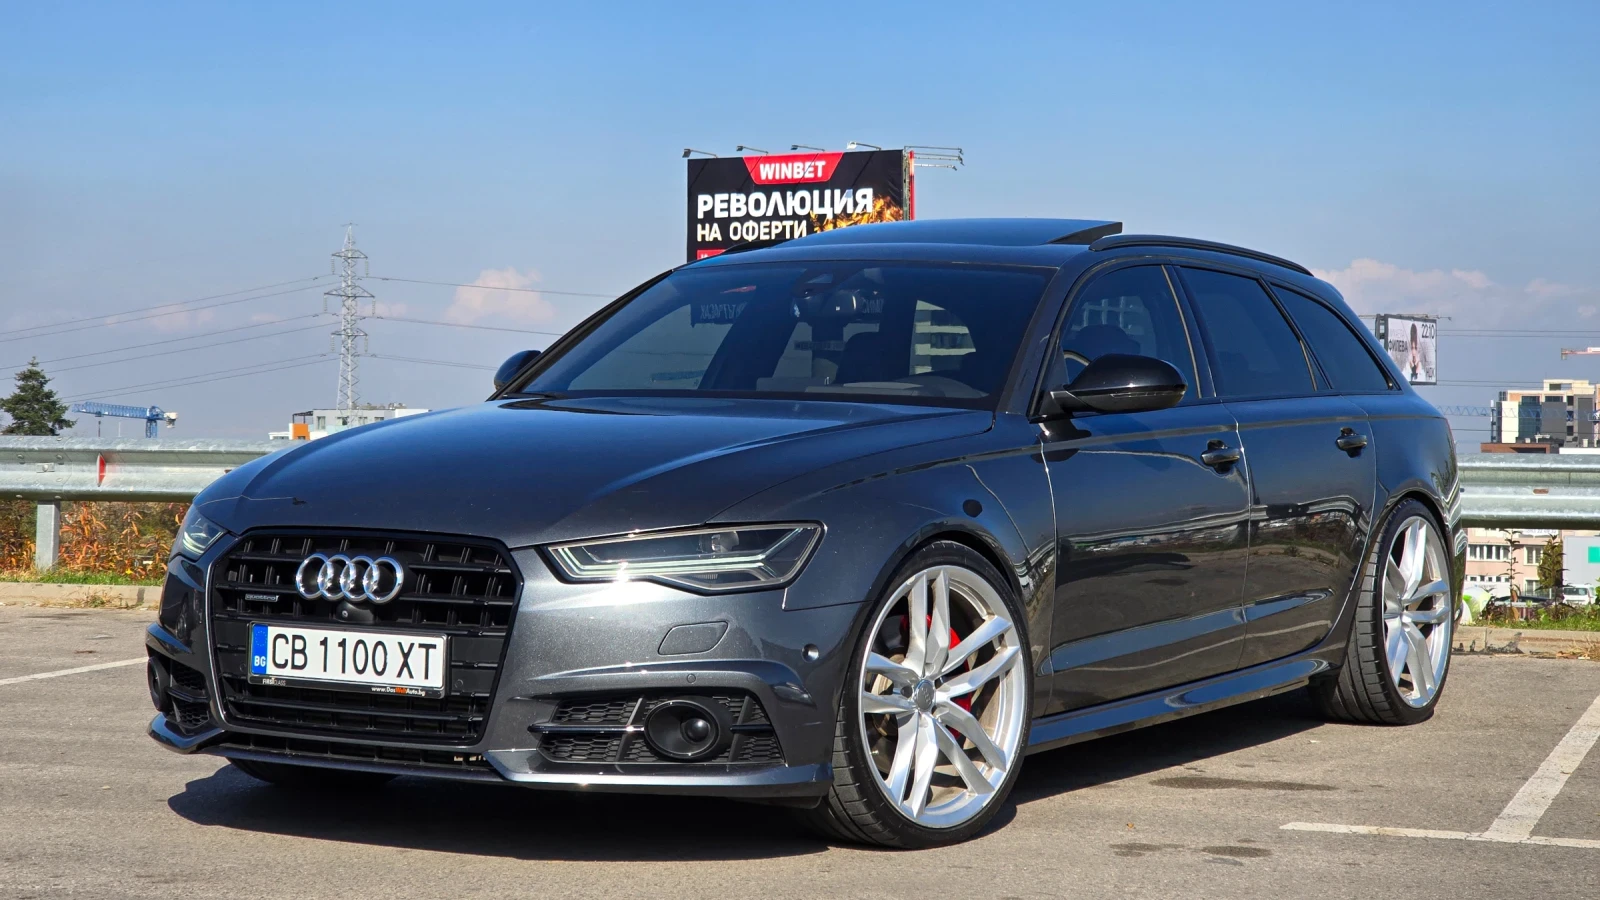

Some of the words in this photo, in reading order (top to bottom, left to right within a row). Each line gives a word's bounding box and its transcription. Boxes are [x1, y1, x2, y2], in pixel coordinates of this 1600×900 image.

[759, 160, 826, 181] WINBET
[697, 188, 873, 219] РЕВОЛЮЦИЯ
[697, 223, 722, 242] НА
[729, 219, 807, 242] ОФЕРТИ
[254, 655, 267, 667] BG
[271, 633, 308, 670] CB
[319, 636, 388, 677] 1100
[396, 641, 437, 680] XT
